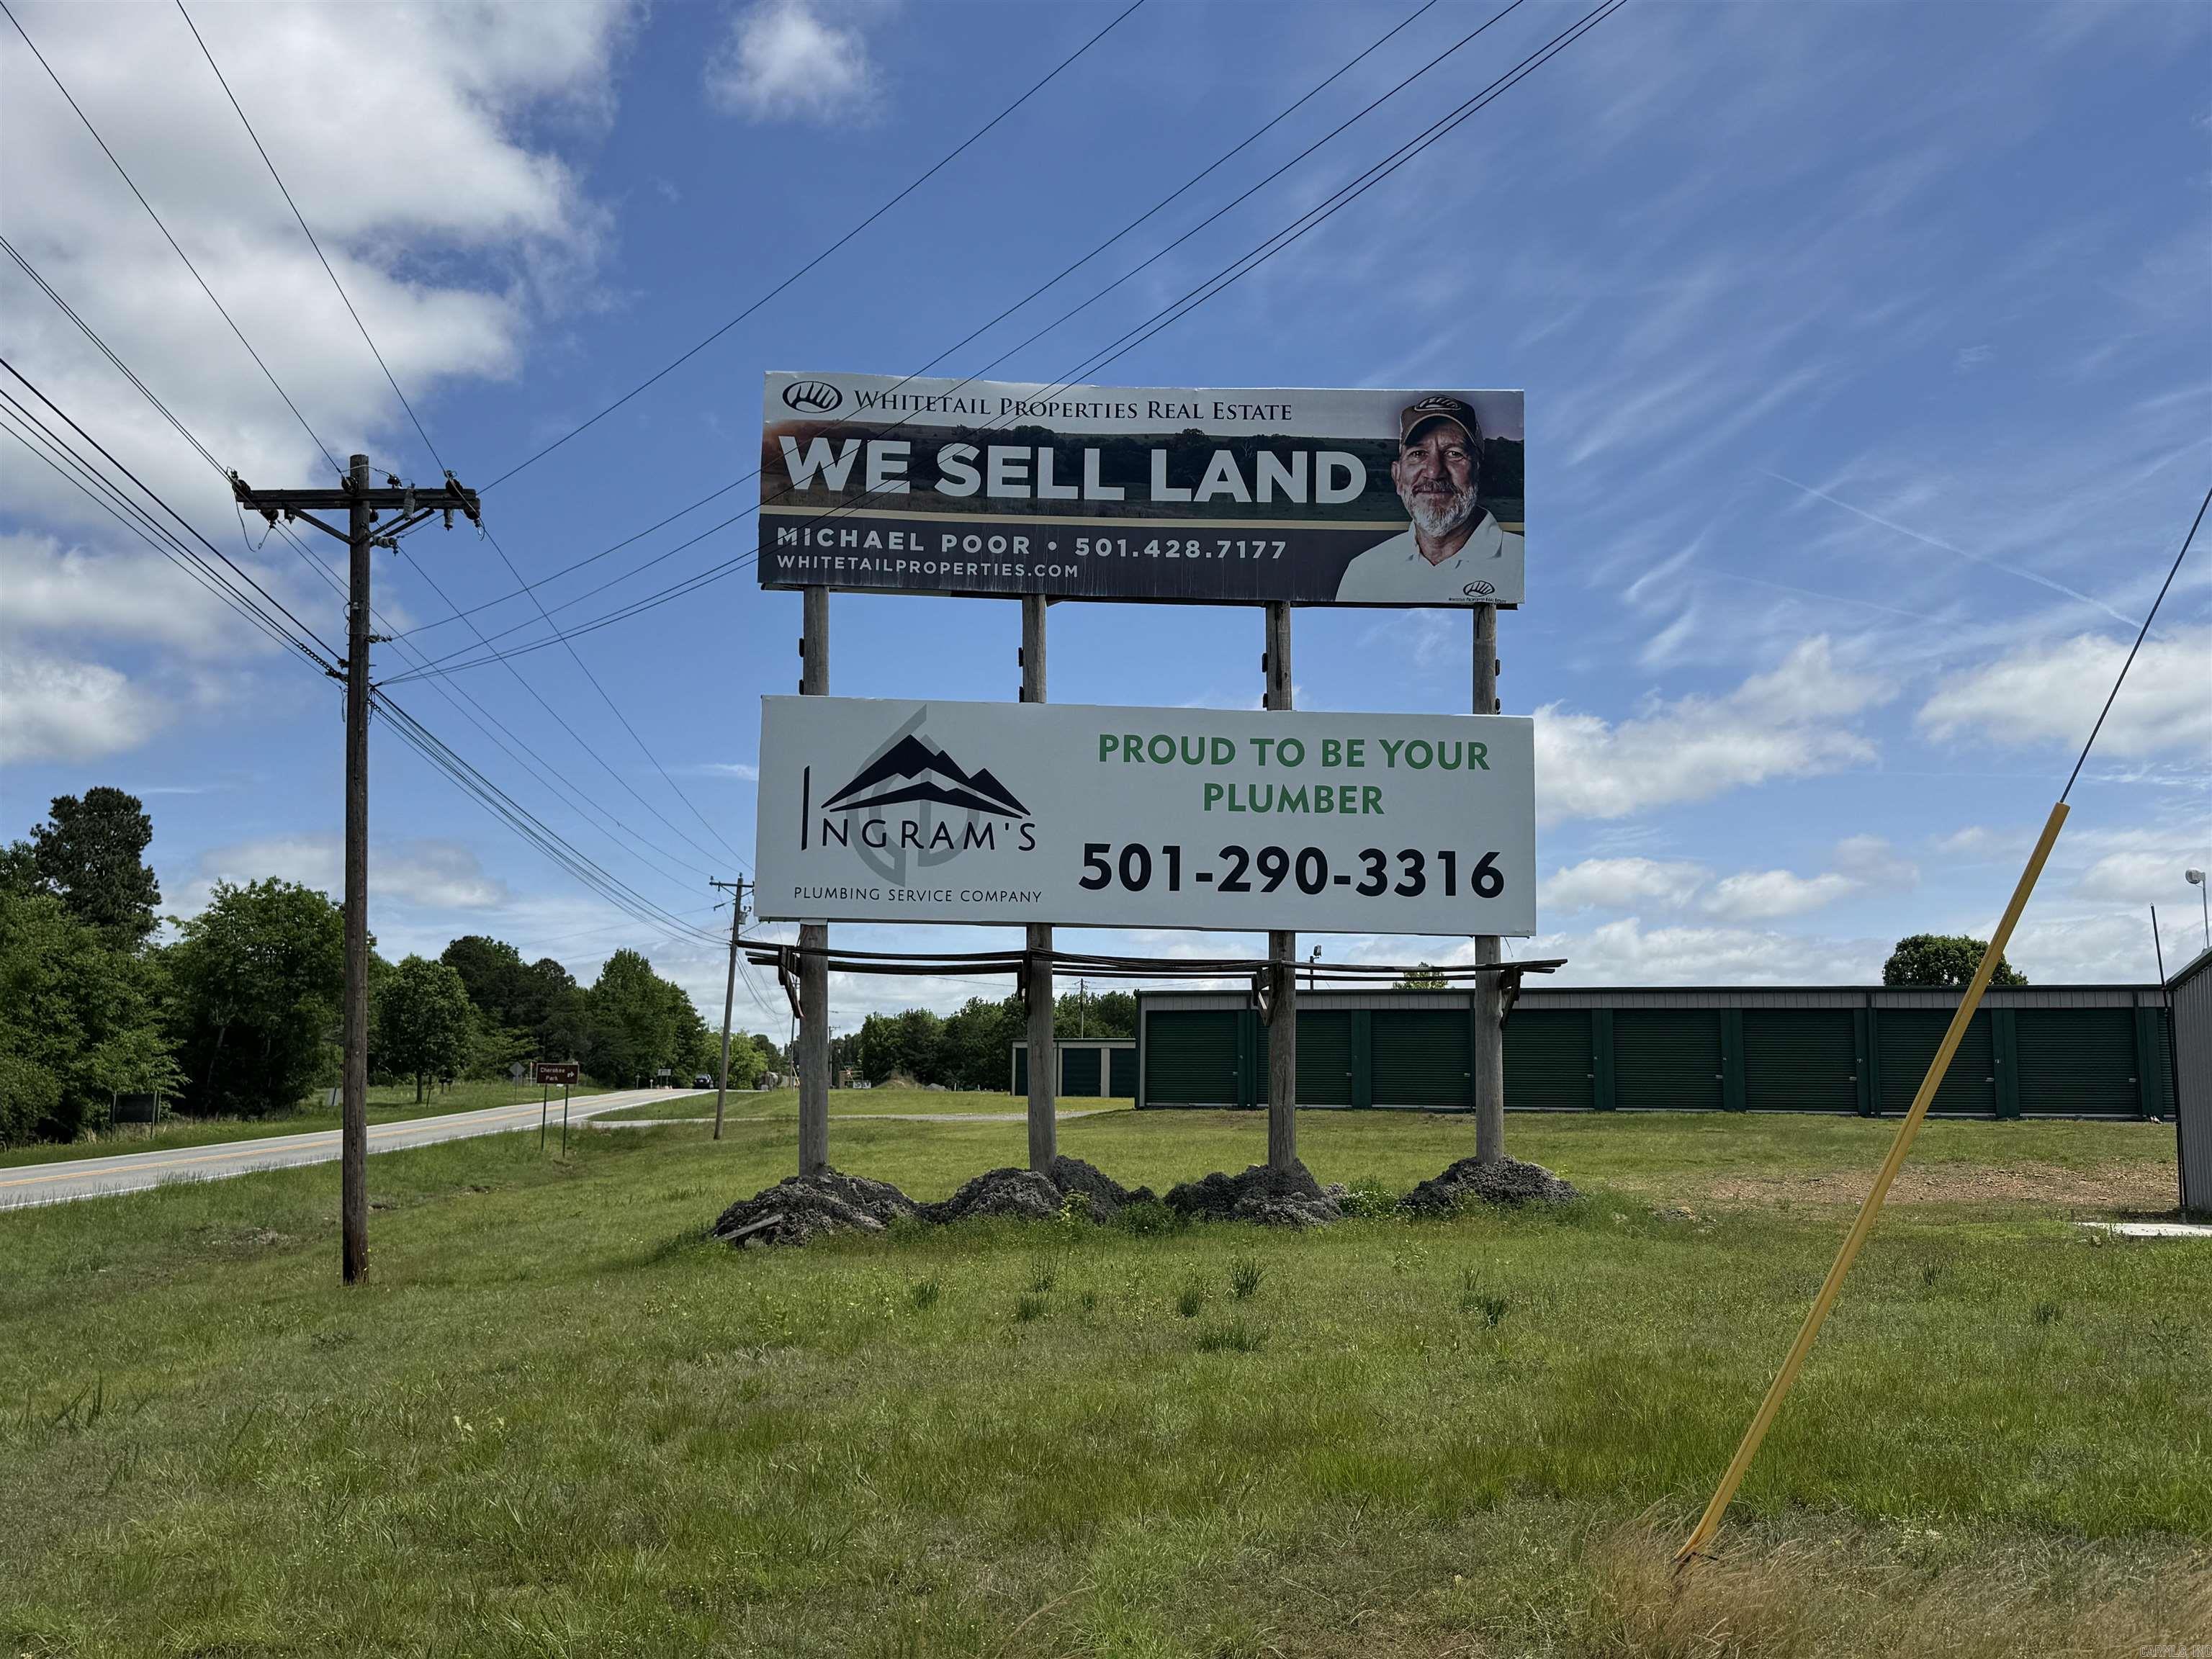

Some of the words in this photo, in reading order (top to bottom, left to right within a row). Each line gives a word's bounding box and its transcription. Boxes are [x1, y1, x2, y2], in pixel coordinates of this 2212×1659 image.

[854, 390, 991, 415] WHITETAIL
[1000, 397, 1138, 419] PROPERTIES
[1148, 400, 1204, 420] REAL
[1213, 401, 1292, 421] ESTATE
[778, 435, 912, 495] WE
[934, 442, 1125, 501] SELL
[1150, 449, 1367, 504] LAND
[777, 526, 925, 552] MICHAEL
[941, 534, 1030, 554] POOR
[1074, 538, 1287, 559] 501.428.7177
[777, 554, 1079, 578] WHITETAILPROPERTIES.COM
[1099, 734, 1236, 765] PROUD
[1249, 737, 1305, 767] TO
[1321, 739, 1365, 768] BE
[1378, 739, 1491, 770] YOUR
[801, 765, 1036, 851] INGRAM'S
[1203, 782, 1385, 815] PLUMBER
[1079, 842, 1506, 899] 501-290-3316
[793, 886, 881, 901] PLUMBING
[887, 888, 953, 903] SERVICE
[960, 890, 1043, 903] COMPANY
